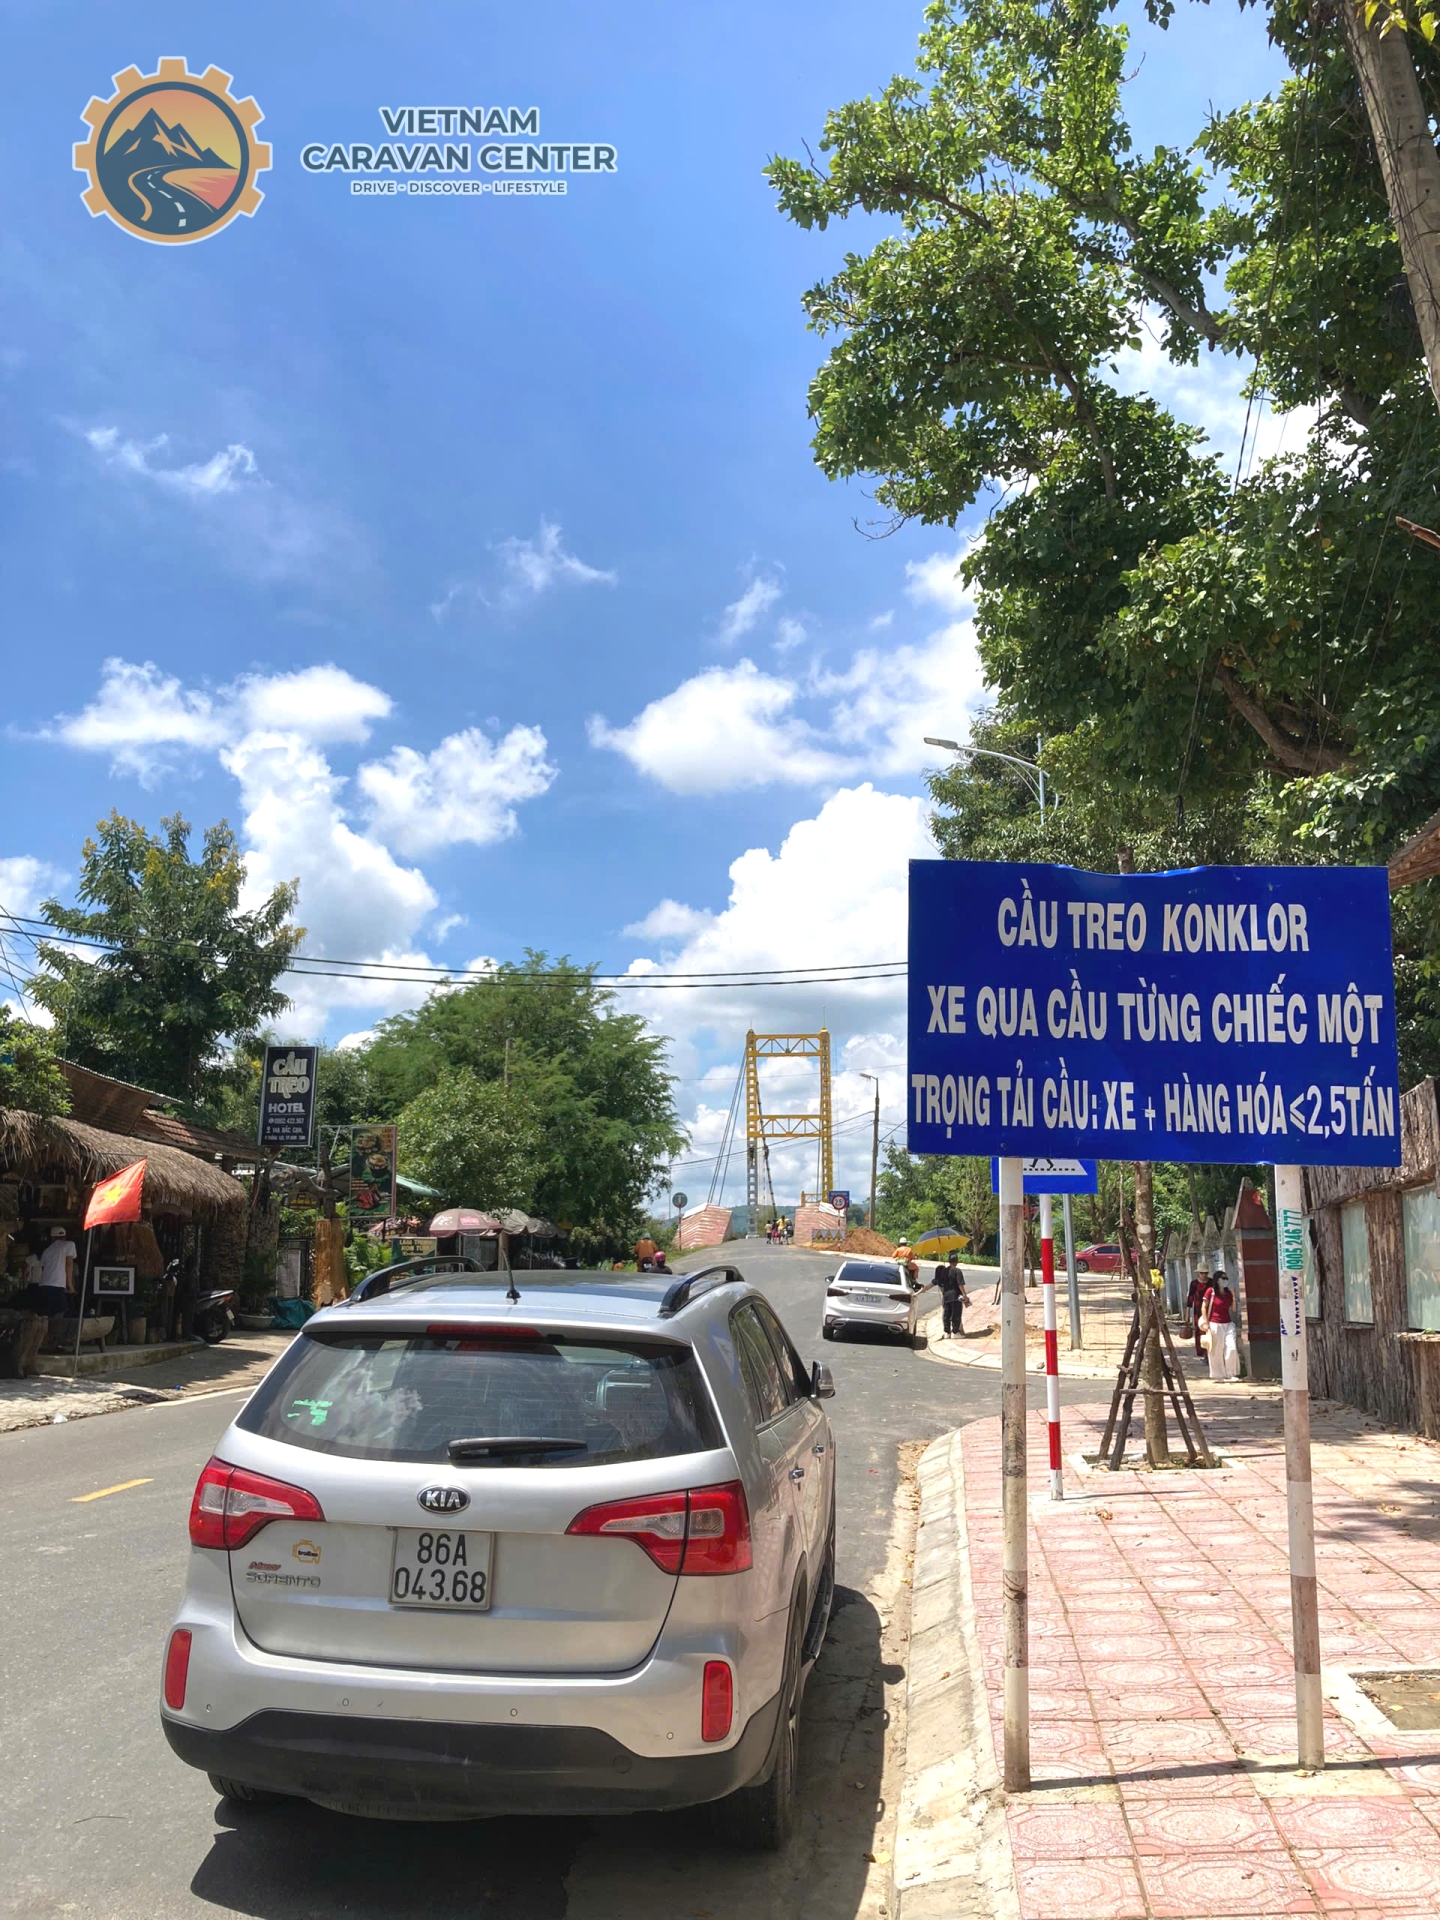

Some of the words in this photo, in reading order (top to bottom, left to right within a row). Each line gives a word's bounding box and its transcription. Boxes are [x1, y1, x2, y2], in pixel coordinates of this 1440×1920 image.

[997, 878, 1058, 949] CẦU
[1067, 901, 1147, 952] TREO
[1162, 902, 1310, 953] KONKLOR
[926, 985, 966, 1034] XE
[976, 985, 1039, 1039] QUA
[1047, 968, 1107, 1041] CẦU
[1117, 977, 1202, 1043] TỪNG
[1211, 973, 1308, 1045] CHIẾC
[1317, 982, 1383, 1058] MỘT
[267, 1076, 310, 1098] TREO
[268, 1103, 305, 1113] HOTEL
[911, 1073, 990, 1139] TRỌNG
[996, 1059, 1034, 1127] TẢI
[1102, 1081, 1137, 1131] XE
[1163, 1072, 1232, 1135] HÀNG
[1283, 1209, 1302, 1227] 777
[1284, 1228, 1303, 1246] 246
[1286, 1248, 1304, 1271] 0905
[425, 1490, 461, 1507] KIA
[417, 1532, 467, 1566] 86A
[246, 1571, 321, 1588] SORENTO
[394, 1567, 486, 1603] 043.68
